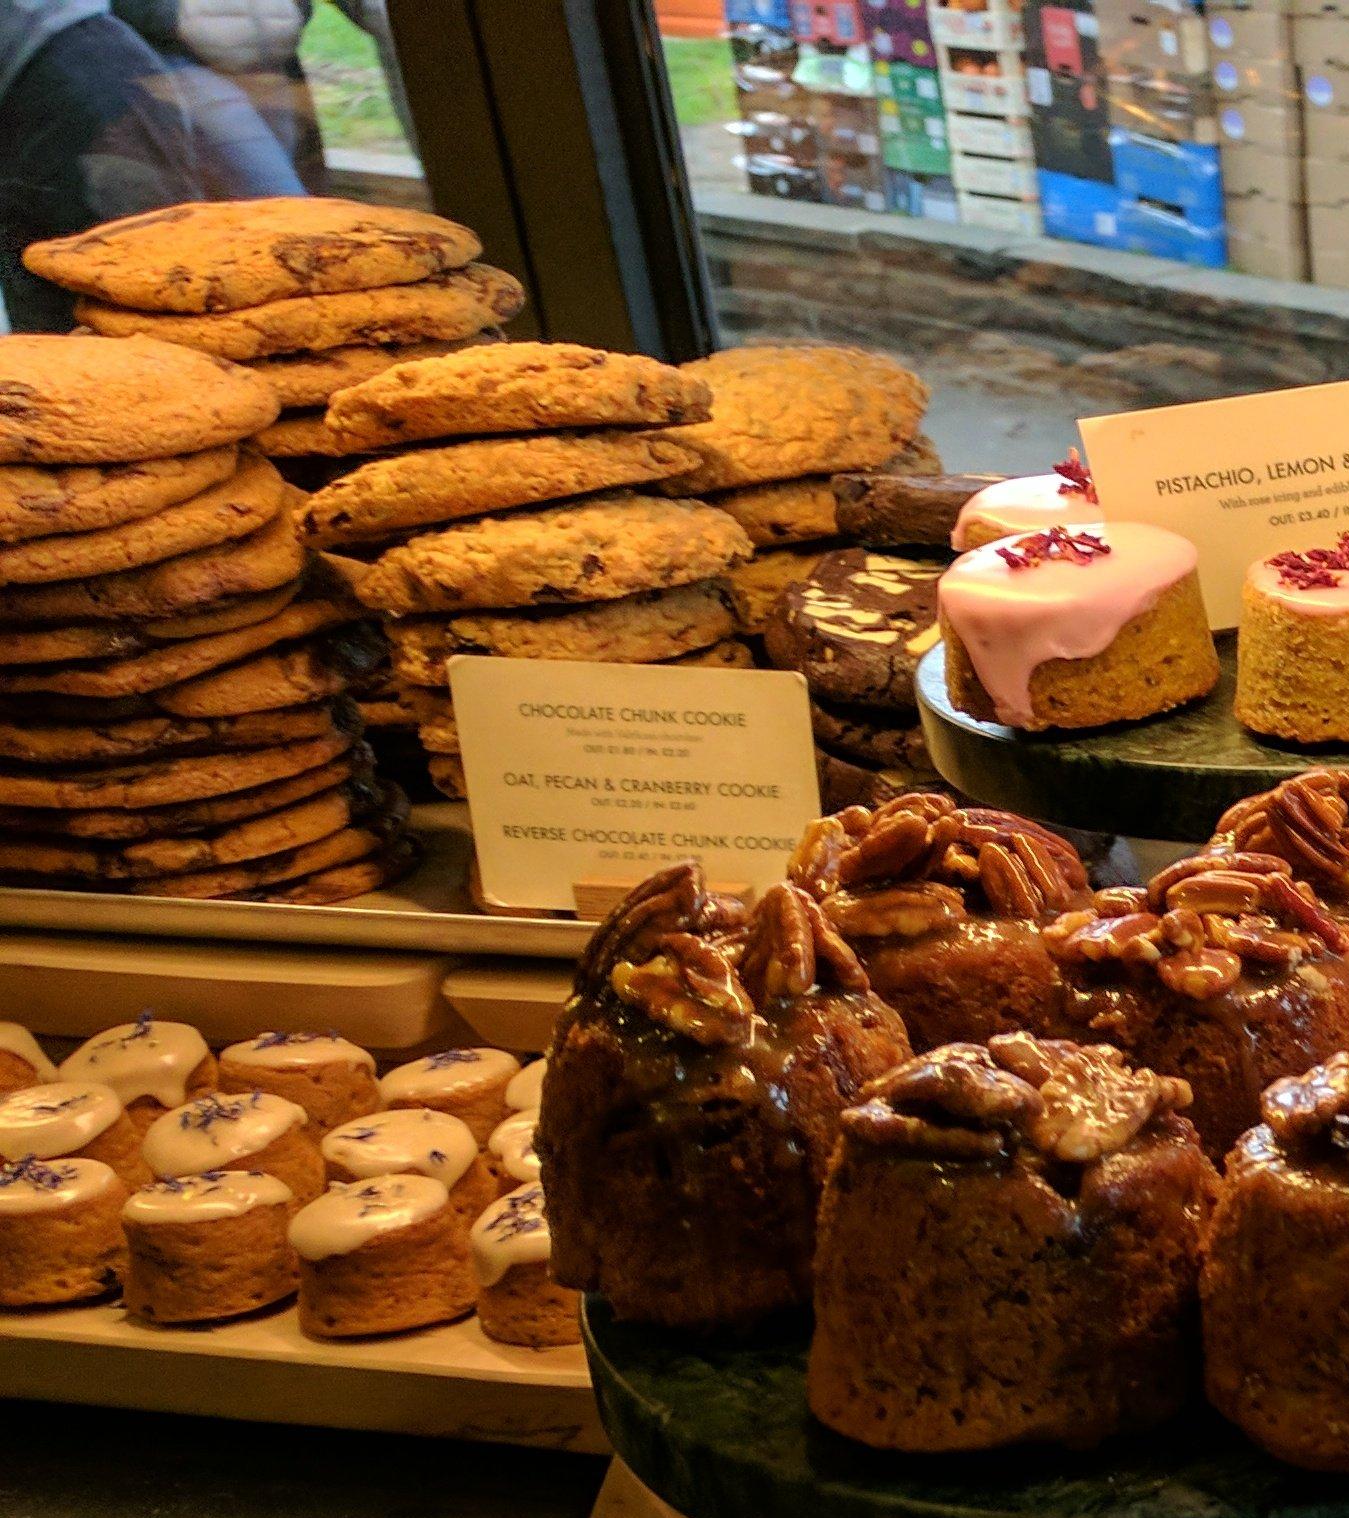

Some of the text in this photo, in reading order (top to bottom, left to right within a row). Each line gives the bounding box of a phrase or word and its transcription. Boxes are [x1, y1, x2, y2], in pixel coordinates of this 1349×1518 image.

[1156, 467, 1262, 496] PISTACHIO,
[1266, 455, 1336, 480] LEMON
[1219, 496, 1247, 509] With
[1249, 496, 1271, 506] rose
[1273, 491, 1301, 503] icing
[1302, 485, 1323, 498] and
[1268, 513, 1296, 526] OUT:
[1298, 508, 1330, 522] £3.40
[518, 703, 747, 728] CHOCOLATE CHUNK COOKIE
[503, 772, 780, 799] OAT, PECAN & CRANBERRY COOKIE
[502, 825, 797, 851] REVERSE CHOCOLATE CHUNK COOKIE
